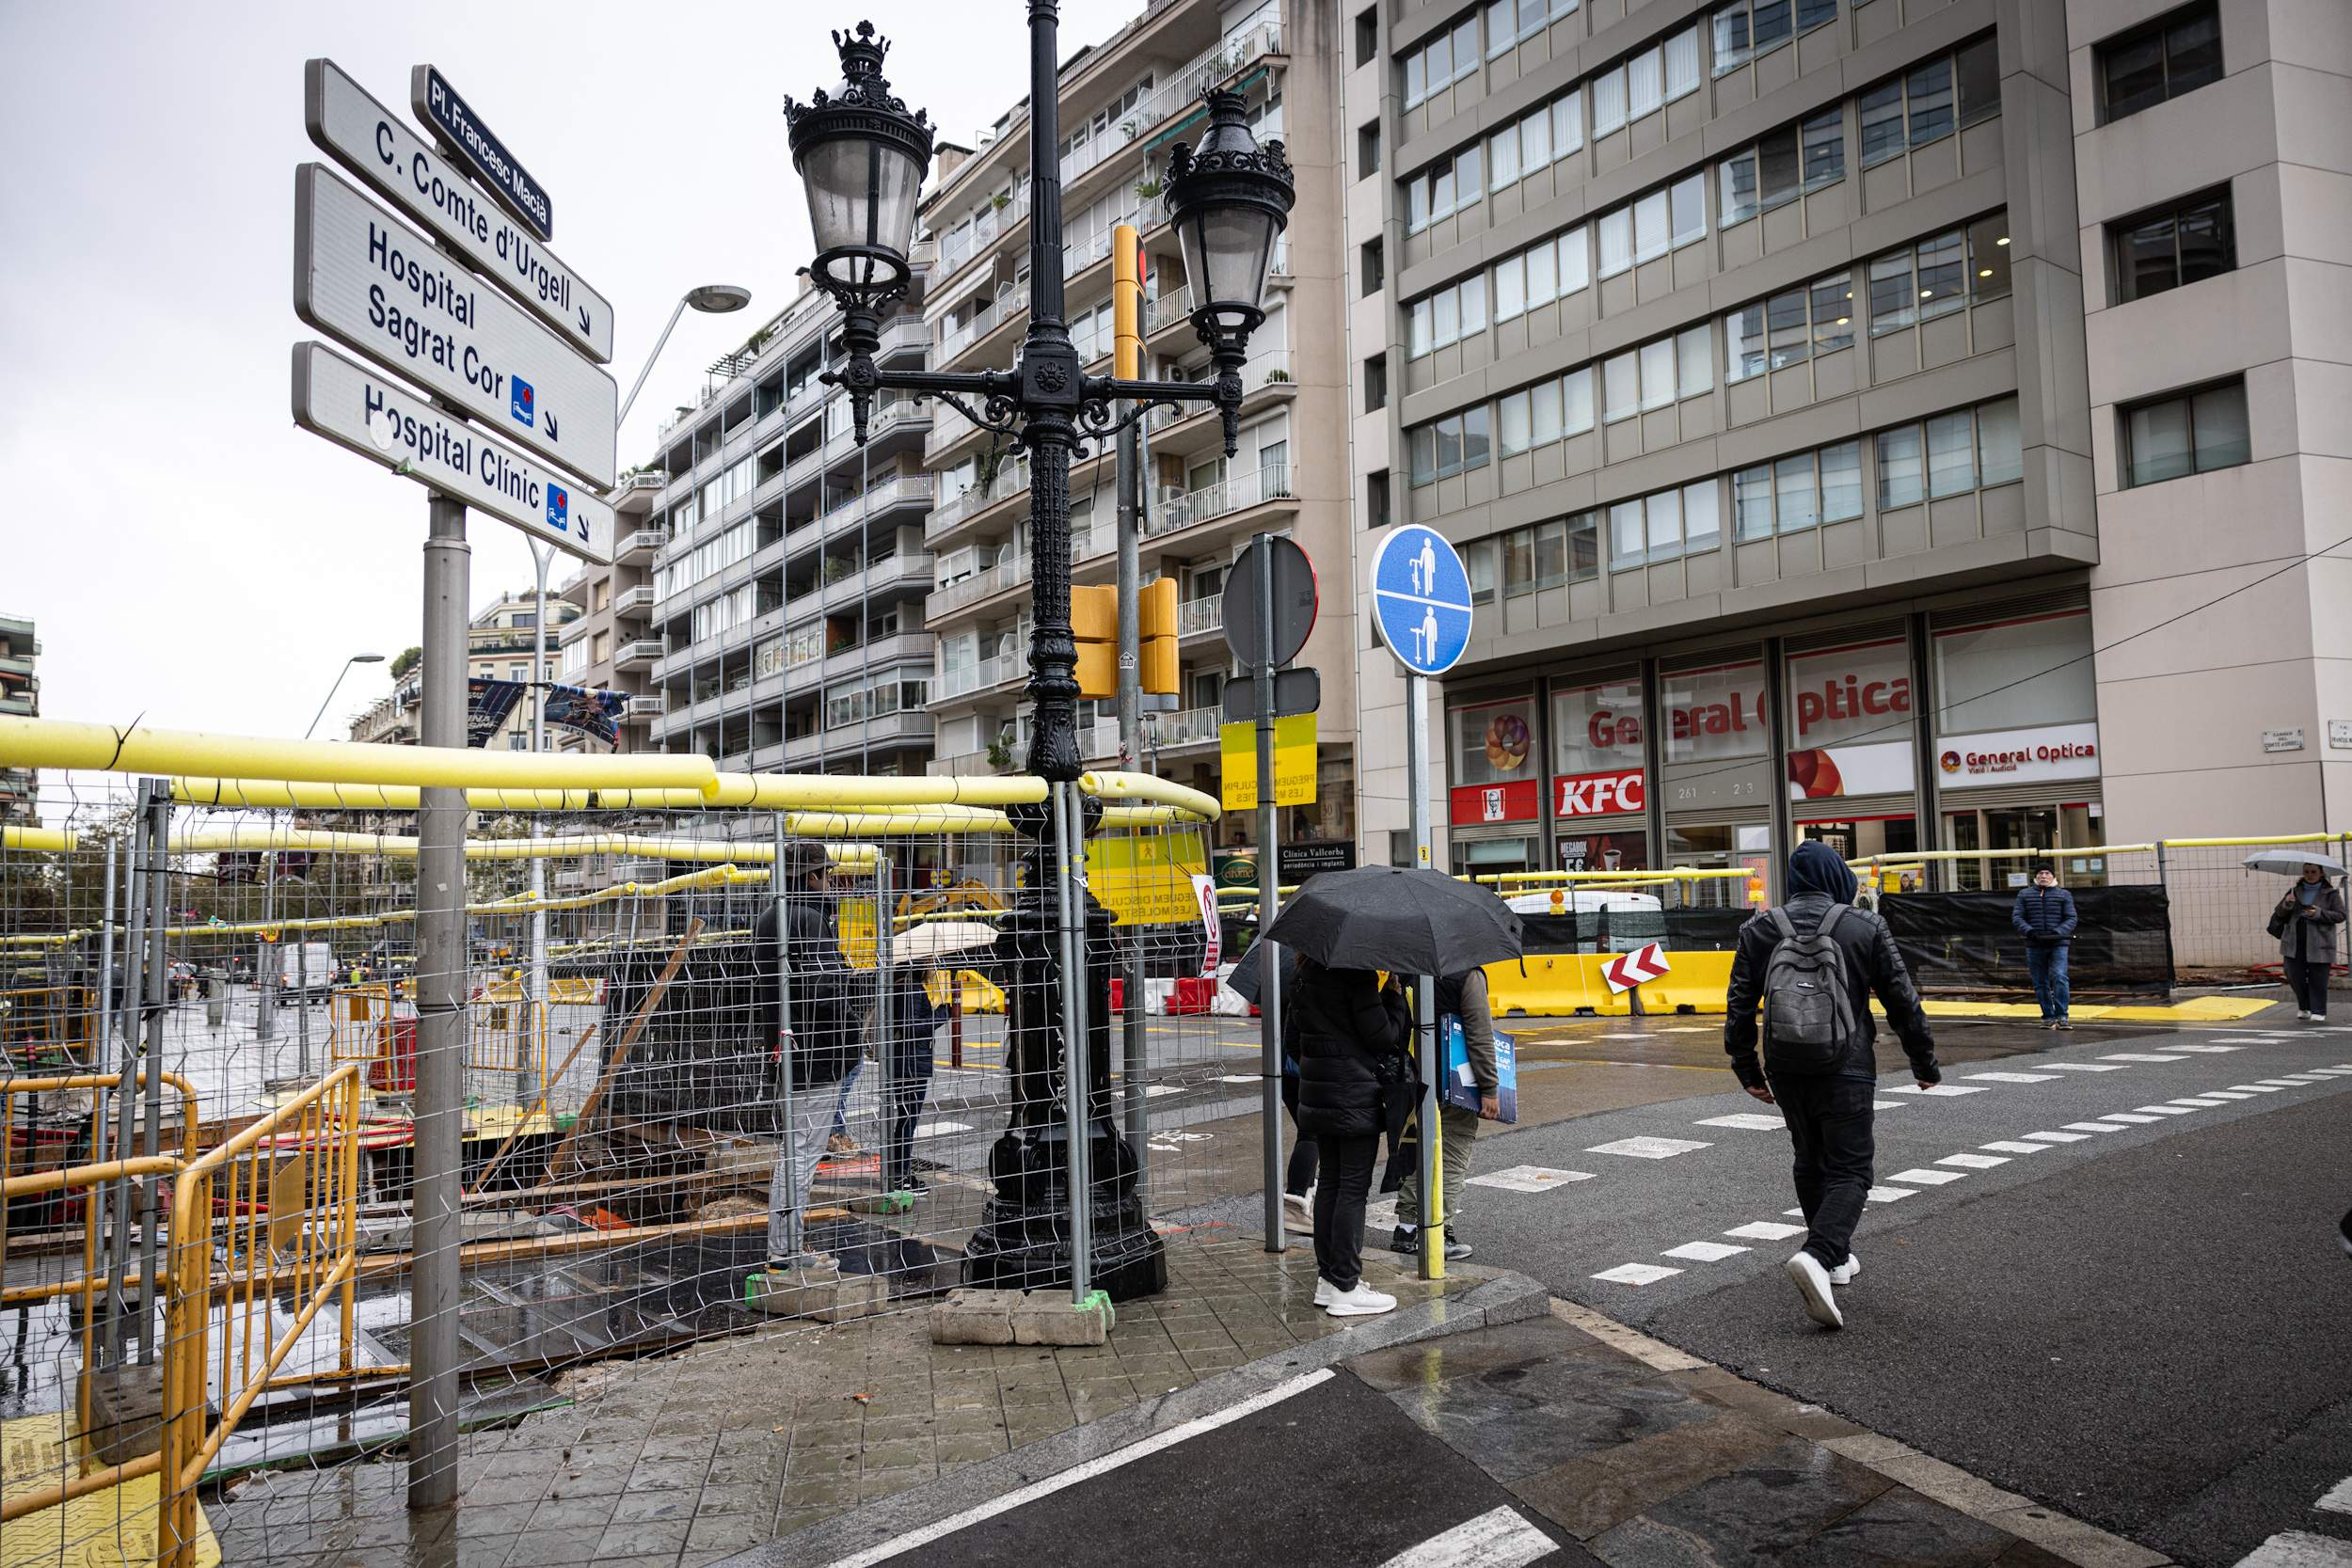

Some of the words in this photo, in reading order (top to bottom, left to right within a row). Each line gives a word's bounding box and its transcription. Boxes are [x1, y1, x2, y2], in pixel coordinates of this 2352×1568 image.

[431, 79, 450, 119] Pl.
[452, 103, 510, 184] Francesc
[513, 169, 547, 225] Macià
[376, 120, 402, 175] C.
[413, 151, 488, 245] Comte
[496, 225, 570, 311] d'Urgell
[369, 221, 474, 330] Hospital
[368, 283, 454, 373] Sagrat
[464, 345, 504, 400] Cor
[365, 384, 471, 475] Hospital
[481, 448, 539, 509] Clínic
[1588, 692, 1747, 748] Geeral
[1966, 748, 2032, 767] General
[2037, 743, 2095, 763] Optica
[1560, 775, 1642, 815] KFC
[1679, 788, 1696, 799] 261
[1283, 849, 1308, 858] Clínica
[1310, 847, 1344, 857] Vallcorba
